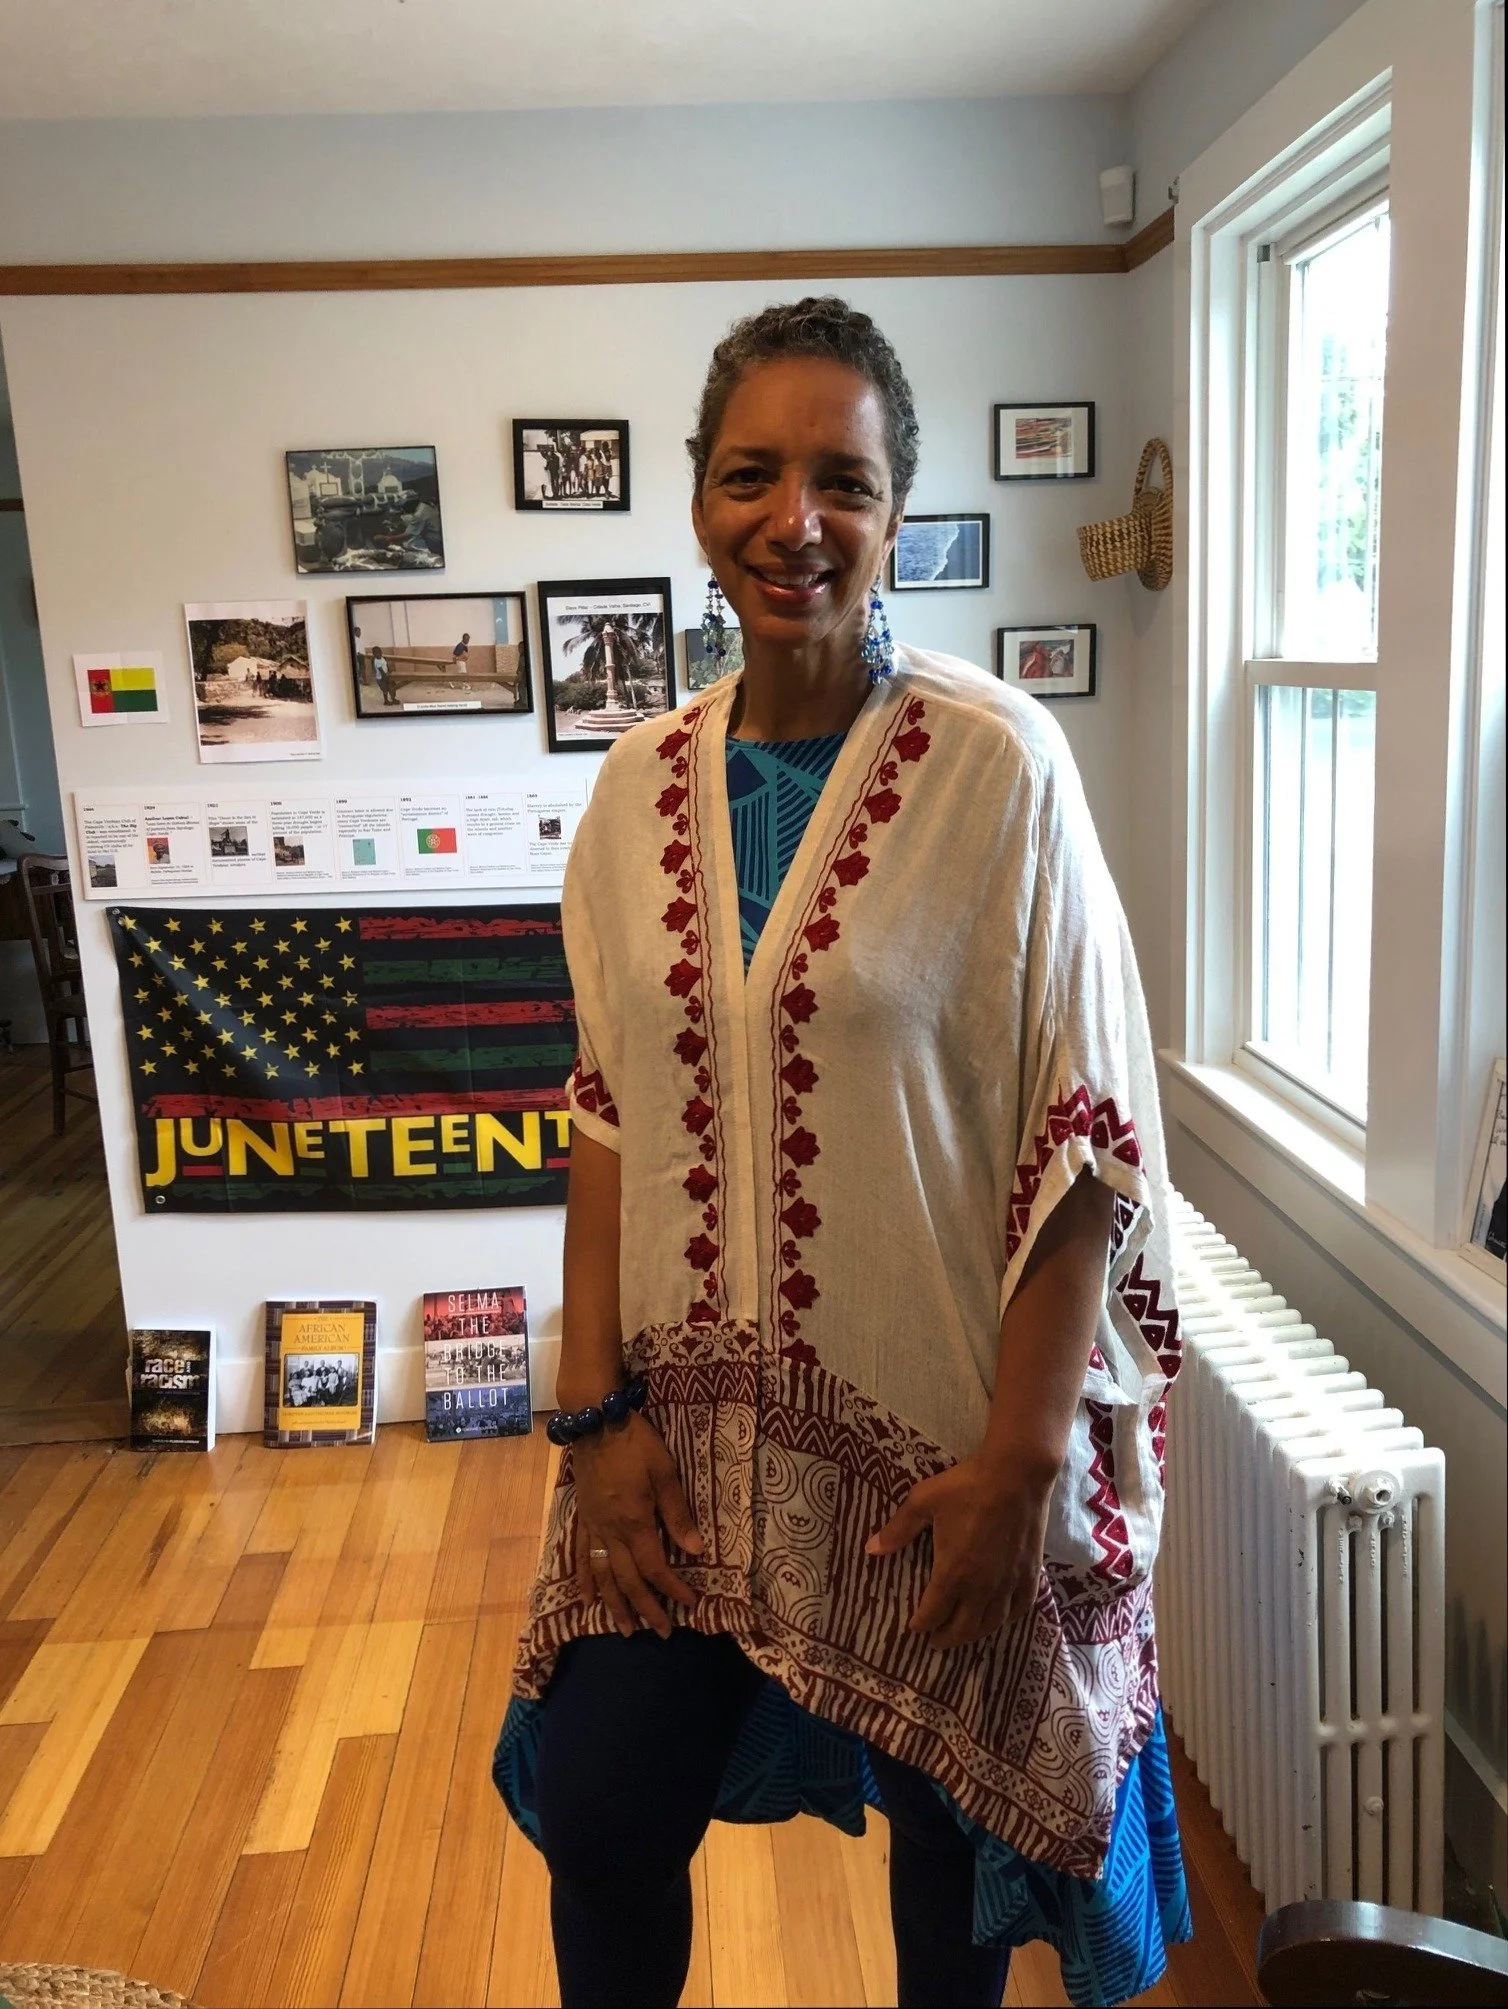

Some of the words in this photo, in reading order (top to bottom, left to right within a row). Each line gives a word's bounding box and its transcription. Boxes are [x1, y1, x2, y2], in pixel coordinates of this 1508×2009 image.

[146, 1110, 571, 1187] JUNETEENT
[448, 1292, 500, 1312] SELMA
[298, 1323, 346, 1333] AFRICAN
[459, 1316, 489, 1336] THE
[294, 1334, 350, 1344] AMERICAN
[444, 1340, 506, 1362] BRIDGE
[144, 1358, 186, 1374] race
[444, 1366, 465, 1385] TO
[476, 1364, 506, 1383] THE
[444, 1388, 509, 1410] BALLOT
